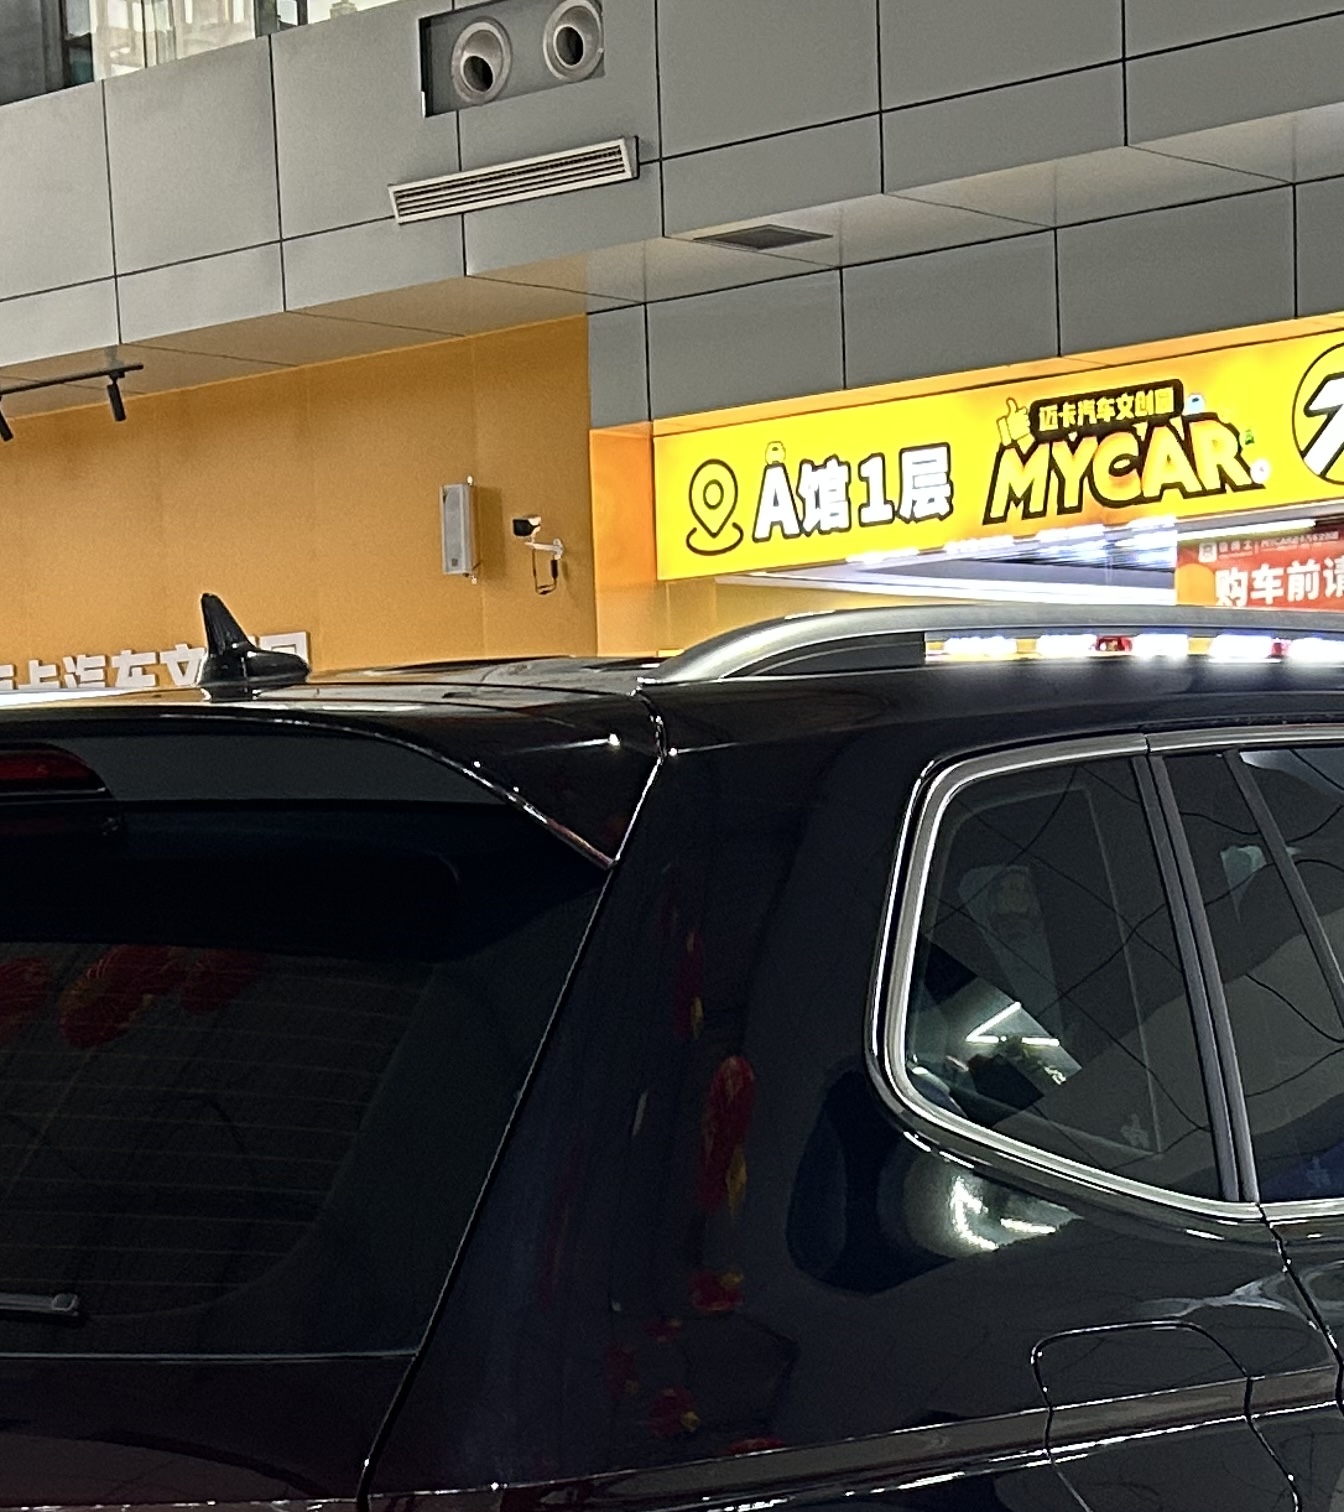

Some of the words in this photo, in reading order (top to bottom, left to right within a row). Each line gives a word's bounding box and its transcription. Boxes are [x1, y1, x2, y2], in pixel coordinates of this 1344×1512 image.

[1038, 387, 1174, 432] 迈卡汽车文创园
[753, 443, 953, 543] A馆1层
[984, 414, 1260, 524] MYCAR
